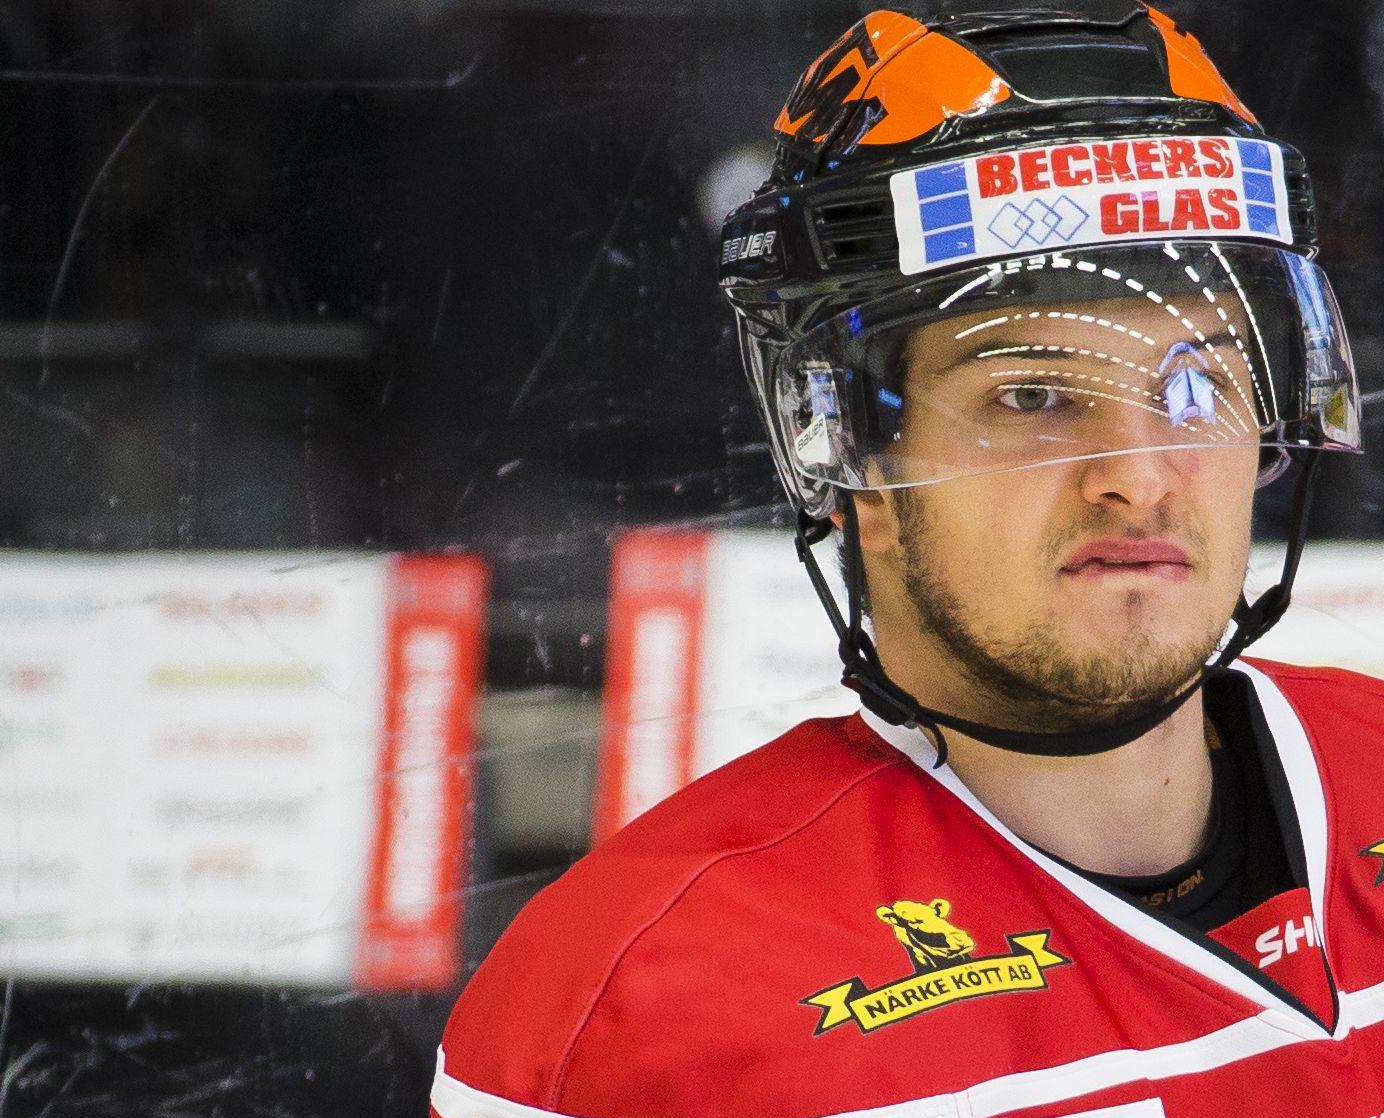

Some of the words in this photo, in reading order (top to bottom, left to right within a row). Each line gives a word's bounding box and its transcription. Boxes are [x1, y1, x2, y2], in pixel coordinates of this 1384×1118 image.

[976, 138, 1236, 200] BECKERS
[1099, 188, 1242, 237] GLAS
[864, 977, 950, 1019] NÄRKE
[950, 966, 1002, 991] KÖTT
[1008, 964, 1032, 982] AB
